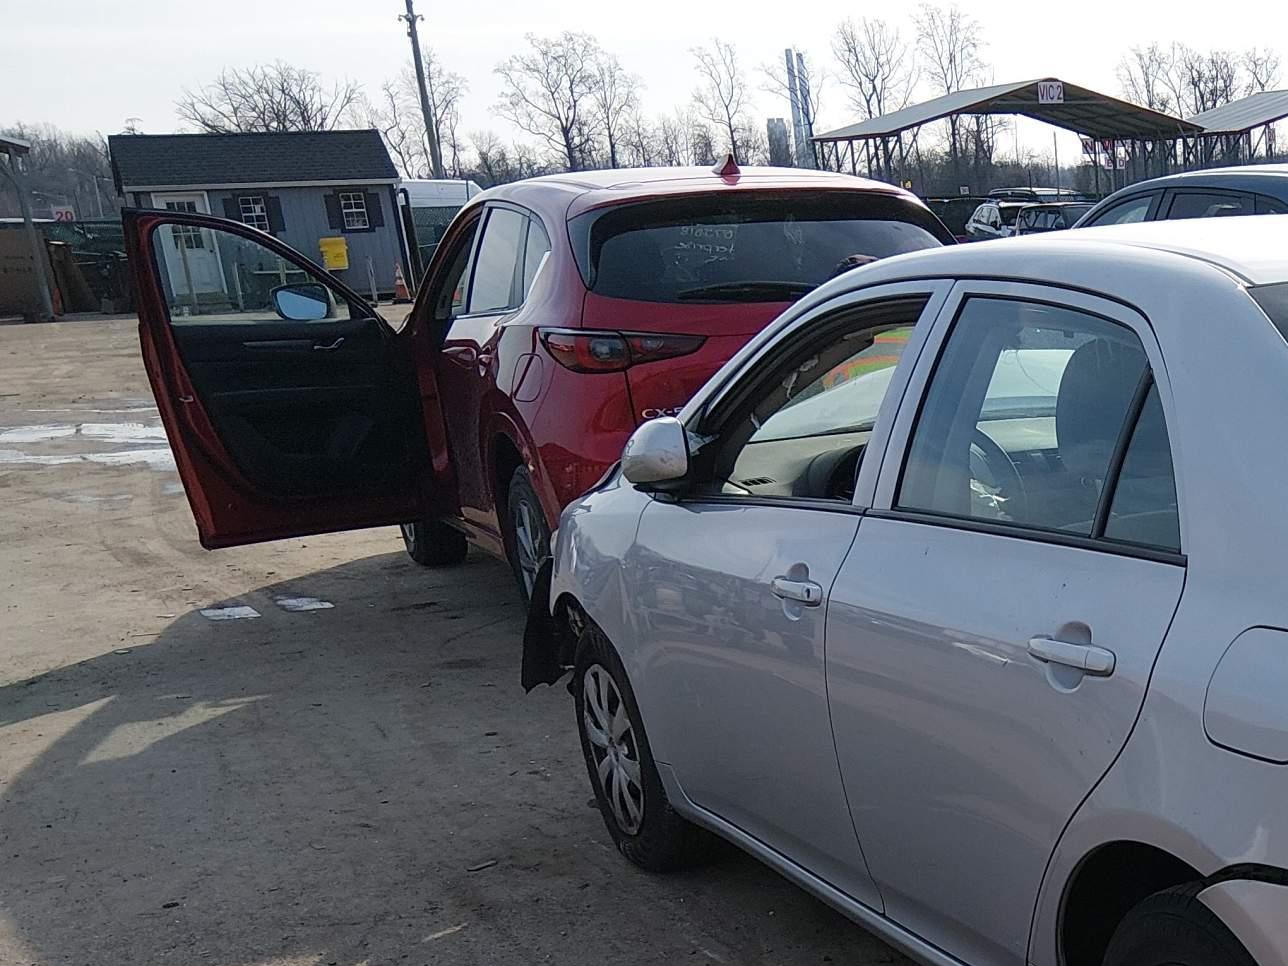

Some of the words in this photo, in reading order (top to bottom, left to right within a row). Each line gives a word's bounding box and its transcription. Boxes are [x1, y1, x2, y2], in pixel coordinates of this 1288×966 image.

[1038, 85, 1055, 100] VIC
[1056, 85, 1063, 100] 2
[55, 210, 75, 223] 20
